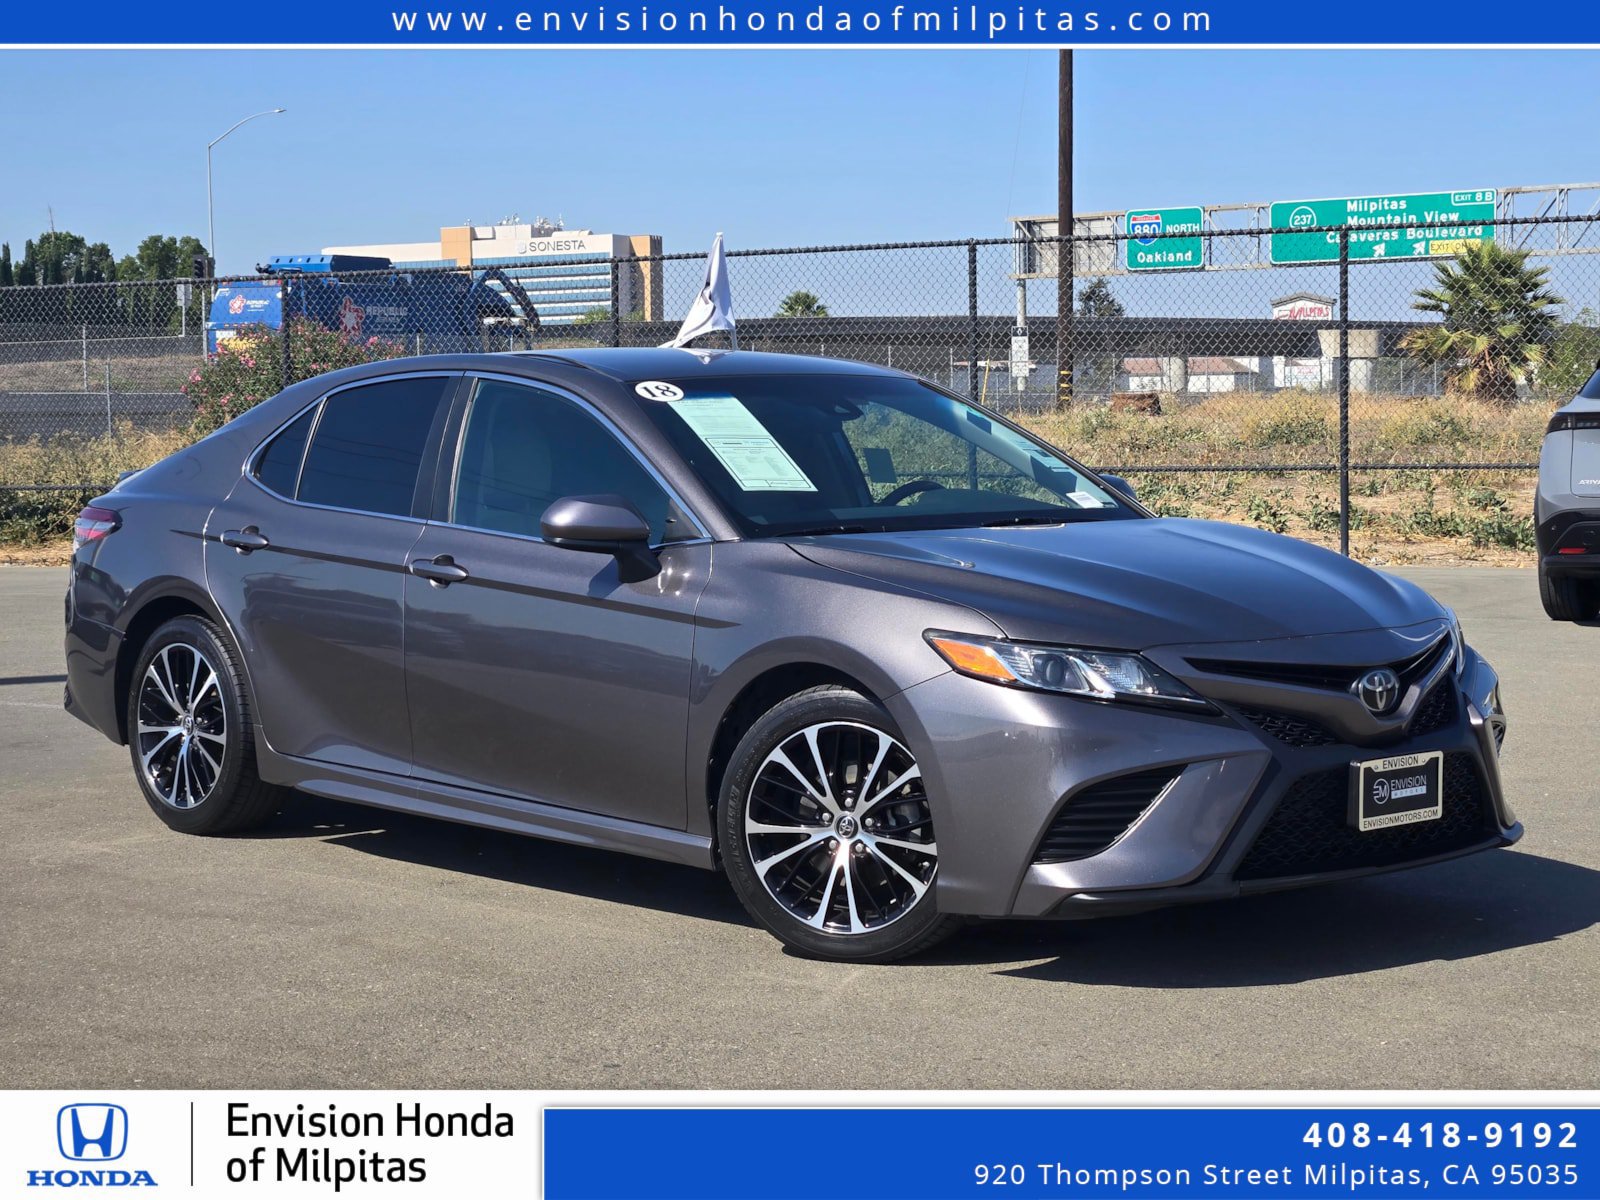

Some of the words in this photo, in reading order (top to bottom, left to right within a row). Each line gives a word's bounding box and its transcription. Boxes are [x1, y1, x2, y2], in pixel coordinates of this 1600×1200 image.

[1347, 198, 1407, 213] Milpitas
[1293, 214, 1313, 226] 237
[1347, 212, 1417, 226] Mountain
[1423, 210, 1460, 223] View
[1134, 224, 1159, 236] 880
[1166, 223, 1200, 233] NORTH
[1326, 230, 1399, 243] Caaveras
[1406, 225, 1483, 240] Boulevard
[529, 240, 586, 252] SONESTA
[1431, 243, 1450, 251] EXIT
[1137, 251, 1192, 263] Oakland
[641, 384, 677, 398] 18
[1382, 756, 1419, 769] ENVISION
[1391, 775, 1427, 790] ENVISION
[1363, 809, 1438, 829] ENVISIONMOTORS.COM
